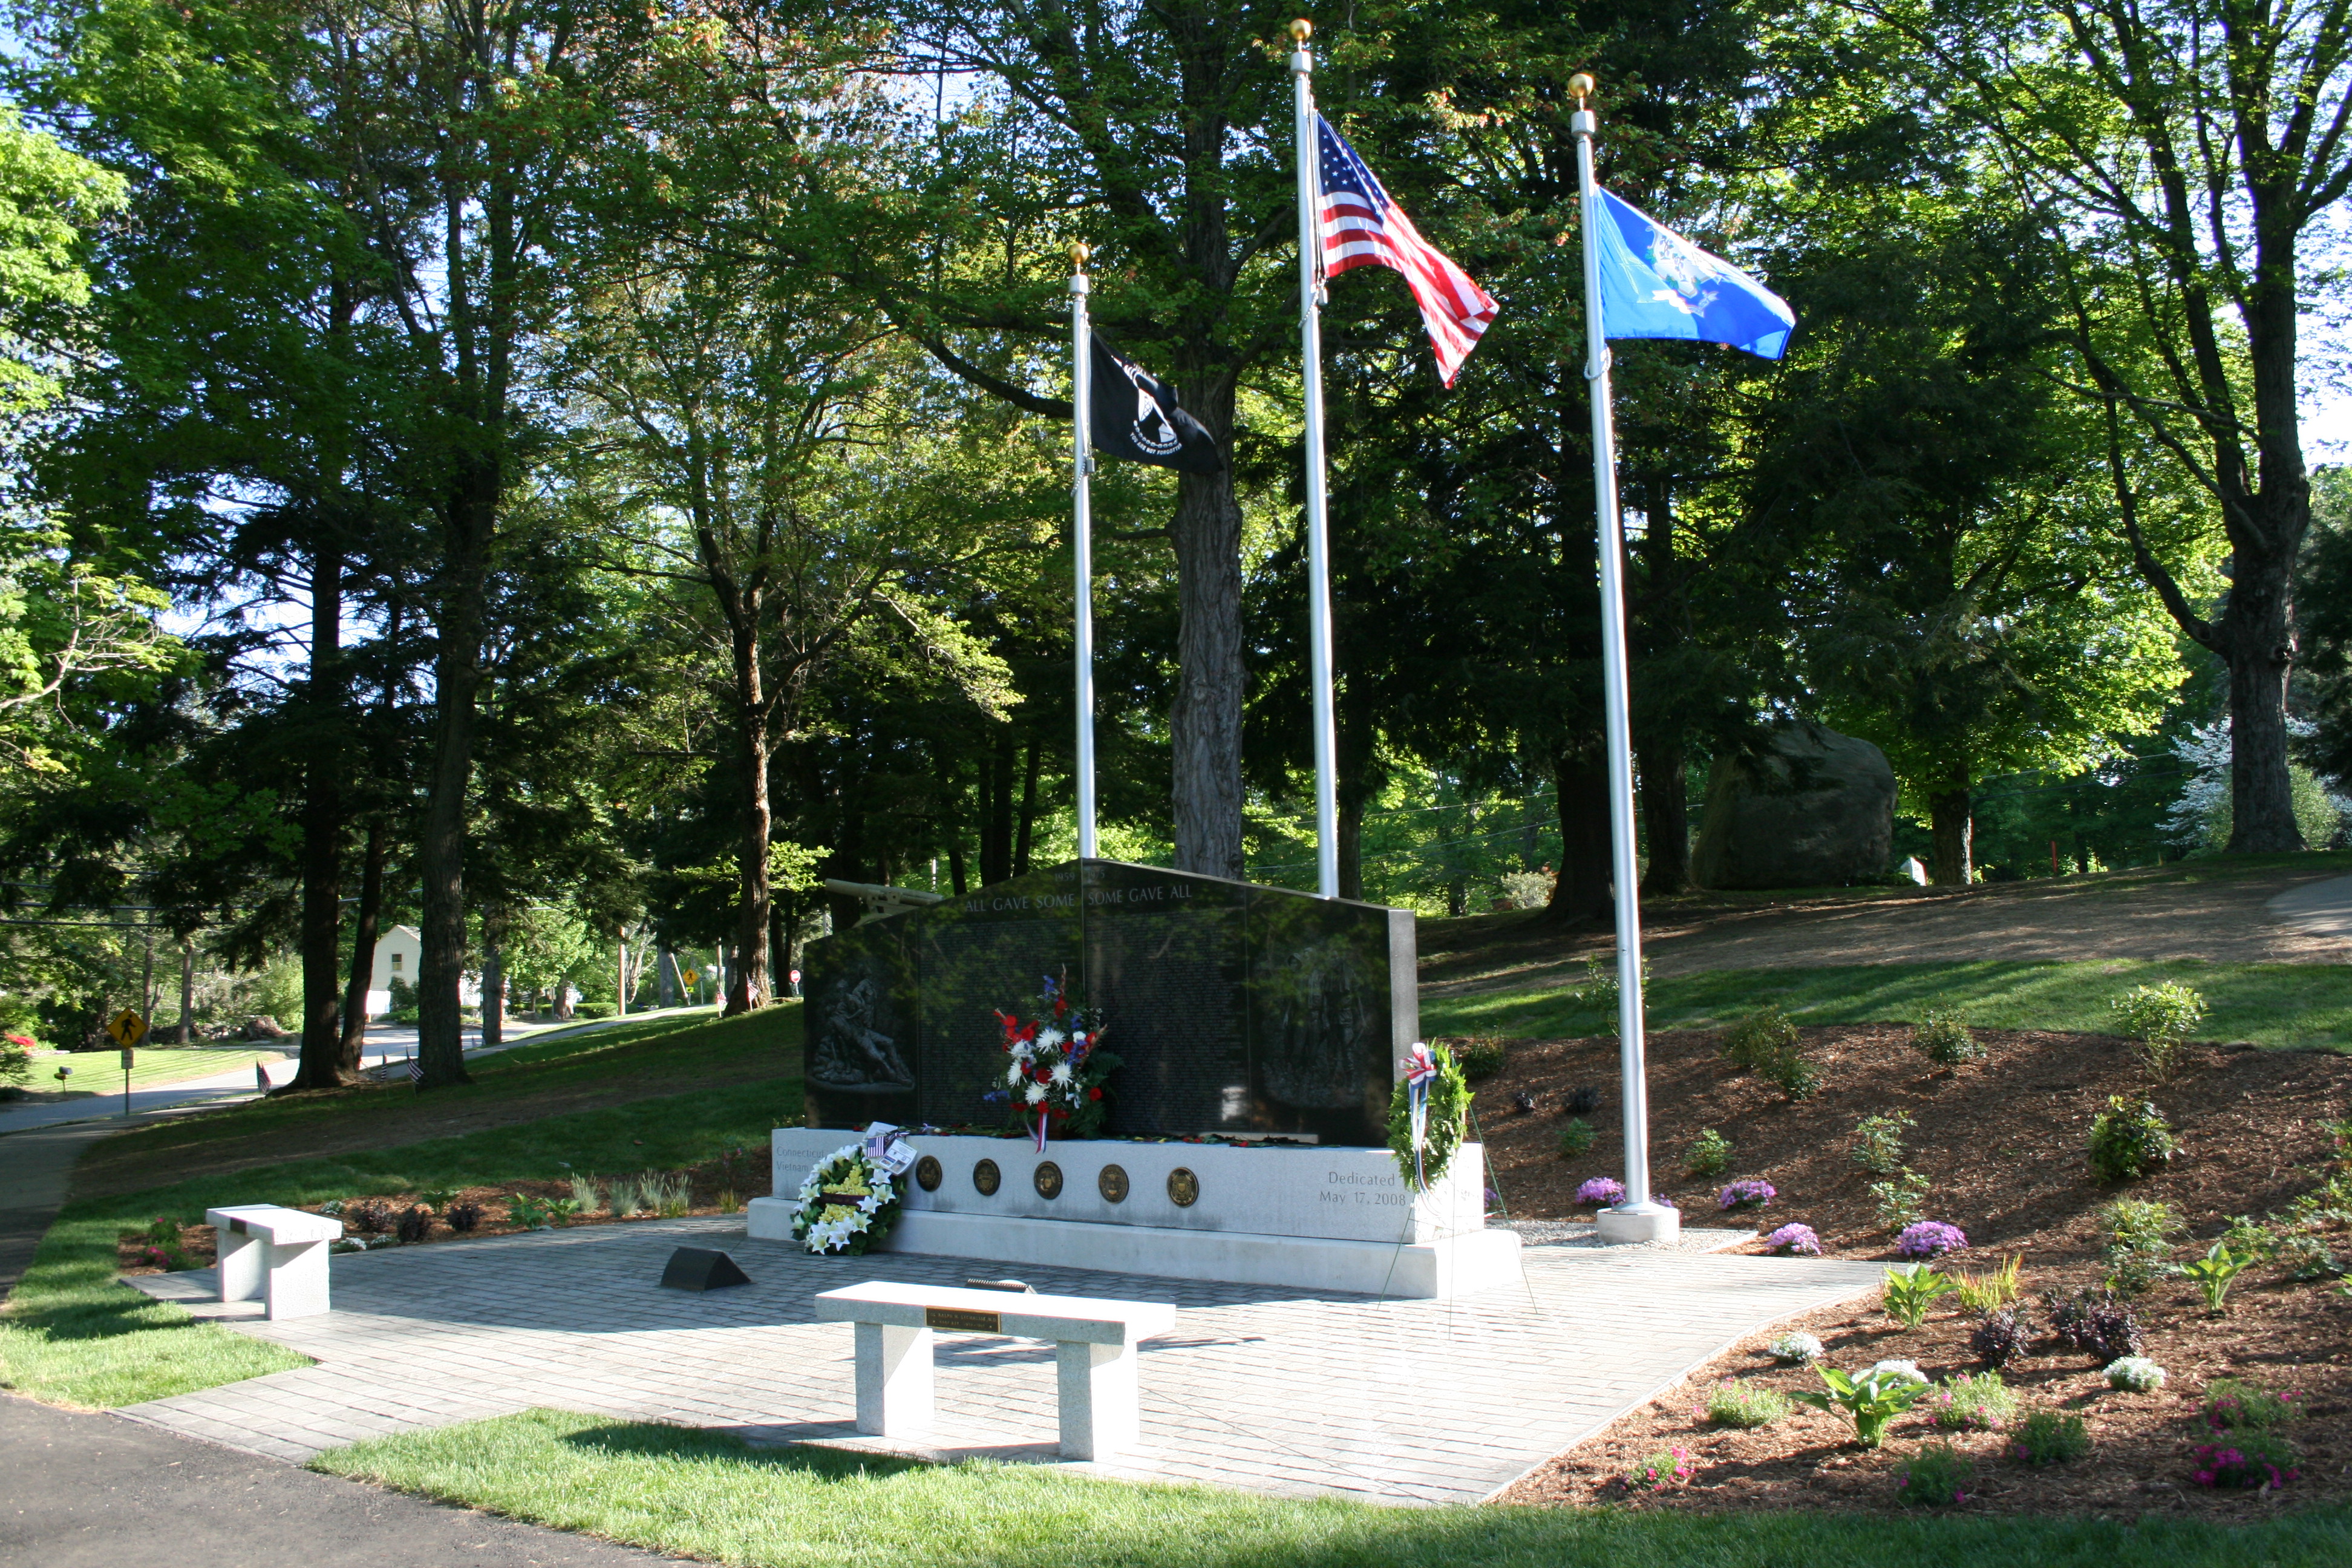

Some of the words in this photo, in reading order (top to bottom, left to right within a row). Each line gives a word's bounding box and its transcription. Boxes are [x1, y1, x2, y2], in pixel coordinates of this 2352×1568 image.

[1054, 872, 1075, 881] 1959
[965, 900, 987, 912] ALL
[993, 897, 1028, 911] GAVE
[1036, 893, 1075, 909] SOME
[1089, 890, 1123, 906] SOME
[1129, 886, 1163, 903] GAVE
[1170, 884, 1192, 899] ALL
[777, 1161, 809, 1172] Vietnam
[1328, 1171, 1395, 1186] Dedicated
[1319, 1191, 1345, 1204] May
[1354, 1192, 1370, 1205] 17,
[1374, 1192, 1406, 1206] 2008
